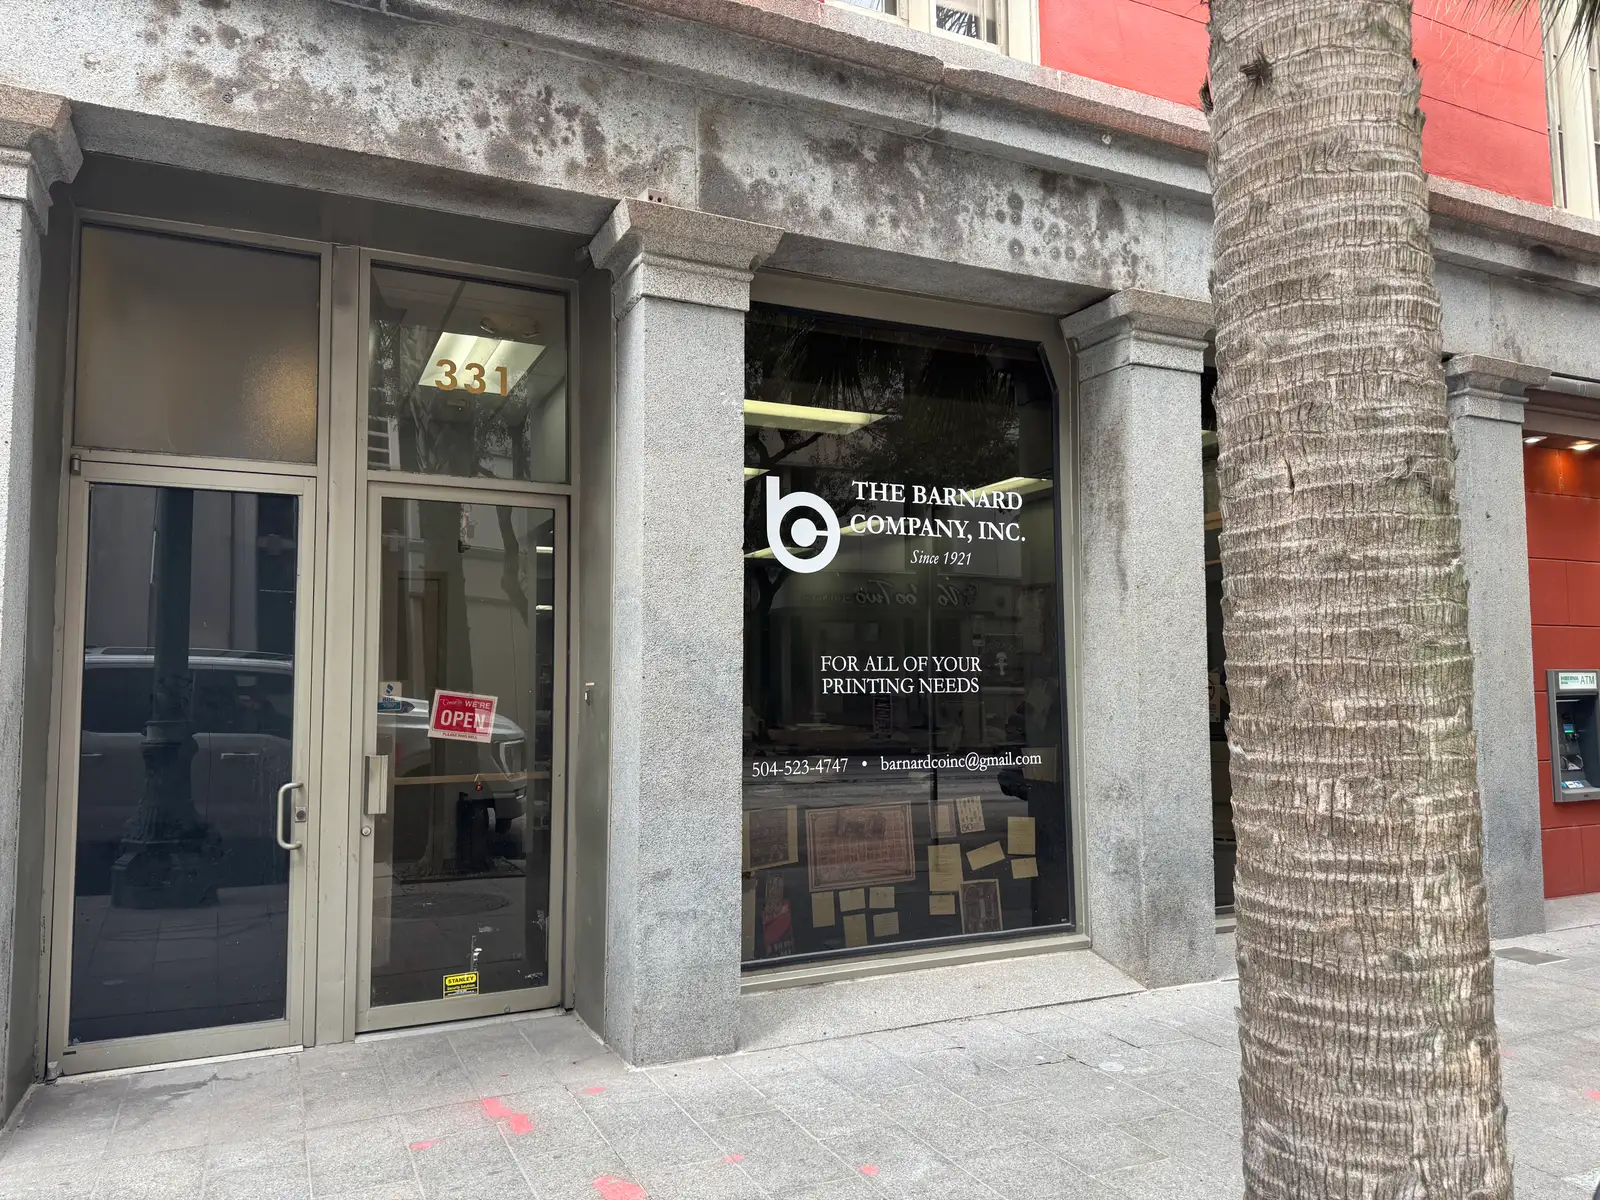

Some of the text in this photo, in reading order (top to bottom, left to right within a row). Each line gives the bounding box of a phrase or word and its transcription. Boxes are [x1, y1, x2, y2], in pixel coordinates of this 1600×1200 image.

[434, 359, 508, 397] 331
[852, 480, 1023, 510] THE BARNARD
[850, 514, 1026, 543] COMPANY, INC.
[910, 550, 972, 566] Since 1921
[820, 655, 982, 672] FOR ALL OF YOUR
[822, 677, 980, 694] PRINTING NEEDS
[1580, 676, 1595, 684] ATM
[465, 700, 491, 710] WE'RE
[440, 709, 486, 729] OPEN
[751, 751, 1042, 777] 504-523-4747 barnardcoinc@gmail.com
[448, 976, 474, 984] STANLEY
